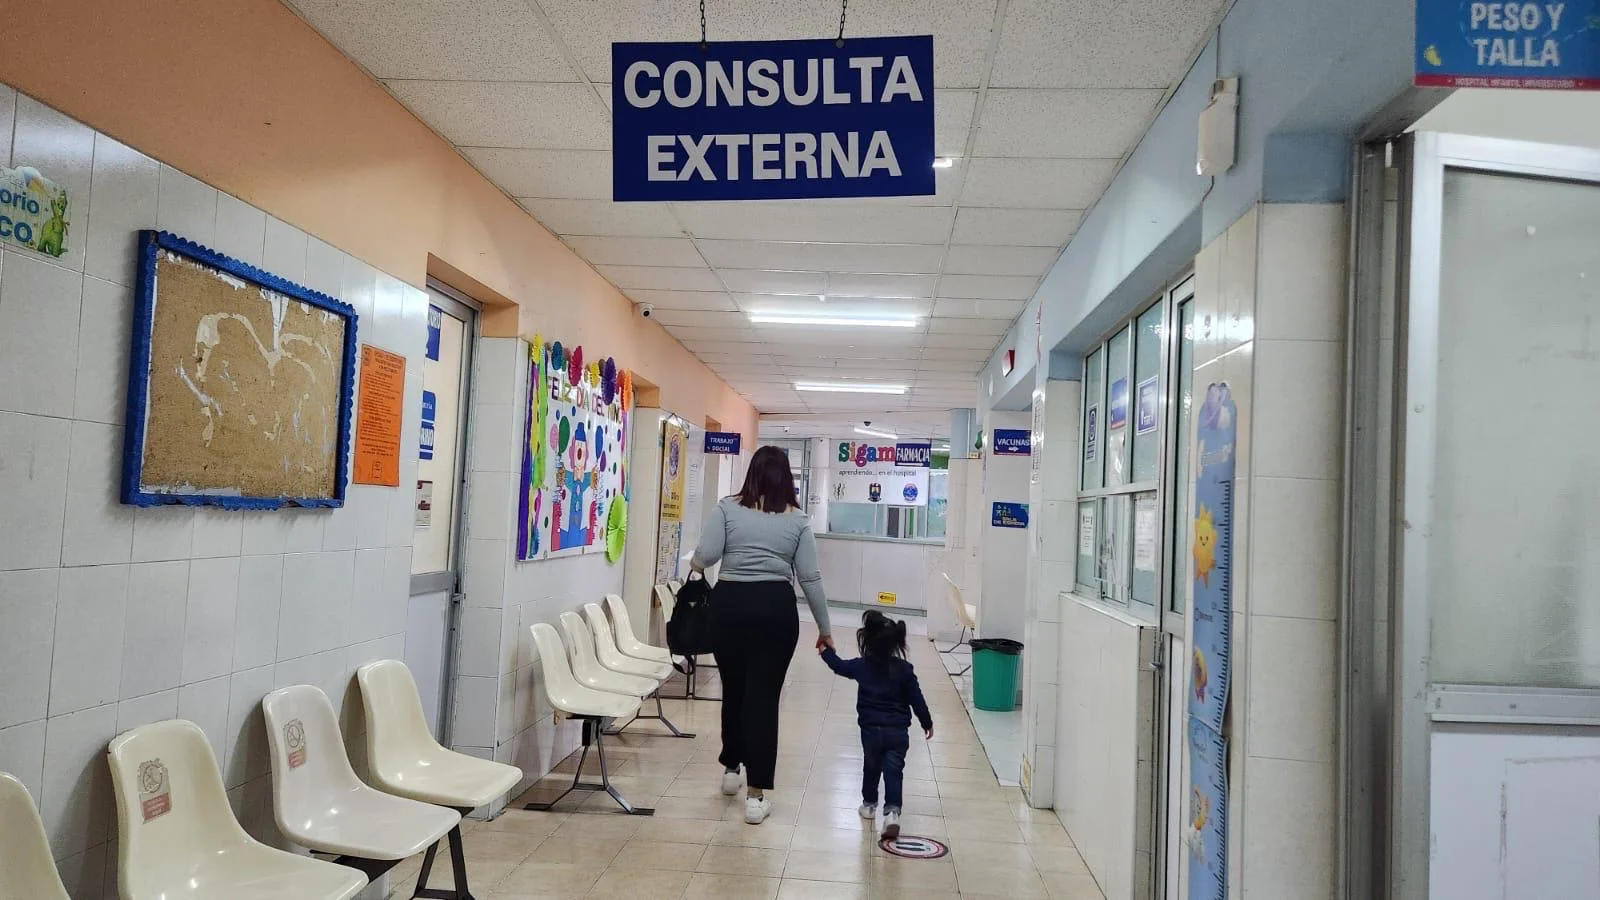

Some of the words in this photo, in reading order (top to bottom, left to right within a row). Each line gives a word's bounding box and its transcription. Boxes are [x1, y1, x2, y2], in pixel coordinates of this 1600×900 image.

[1471, 3, 1541, 32] PESO
[1545, 3, 1565, 31] Y
[1473, 38, 1560, 67] TALLA
[624, 55, 923, 108] CONSULTA
[648, 130, 902, 182] EXTERNA
[710, 437, 734, 445] TRABAJO
[712, 445, 730, 453] SOCIAL
[997, 438, 1031, 447] VACUNAS
[896, 447, 930, 463] FARMACIA
